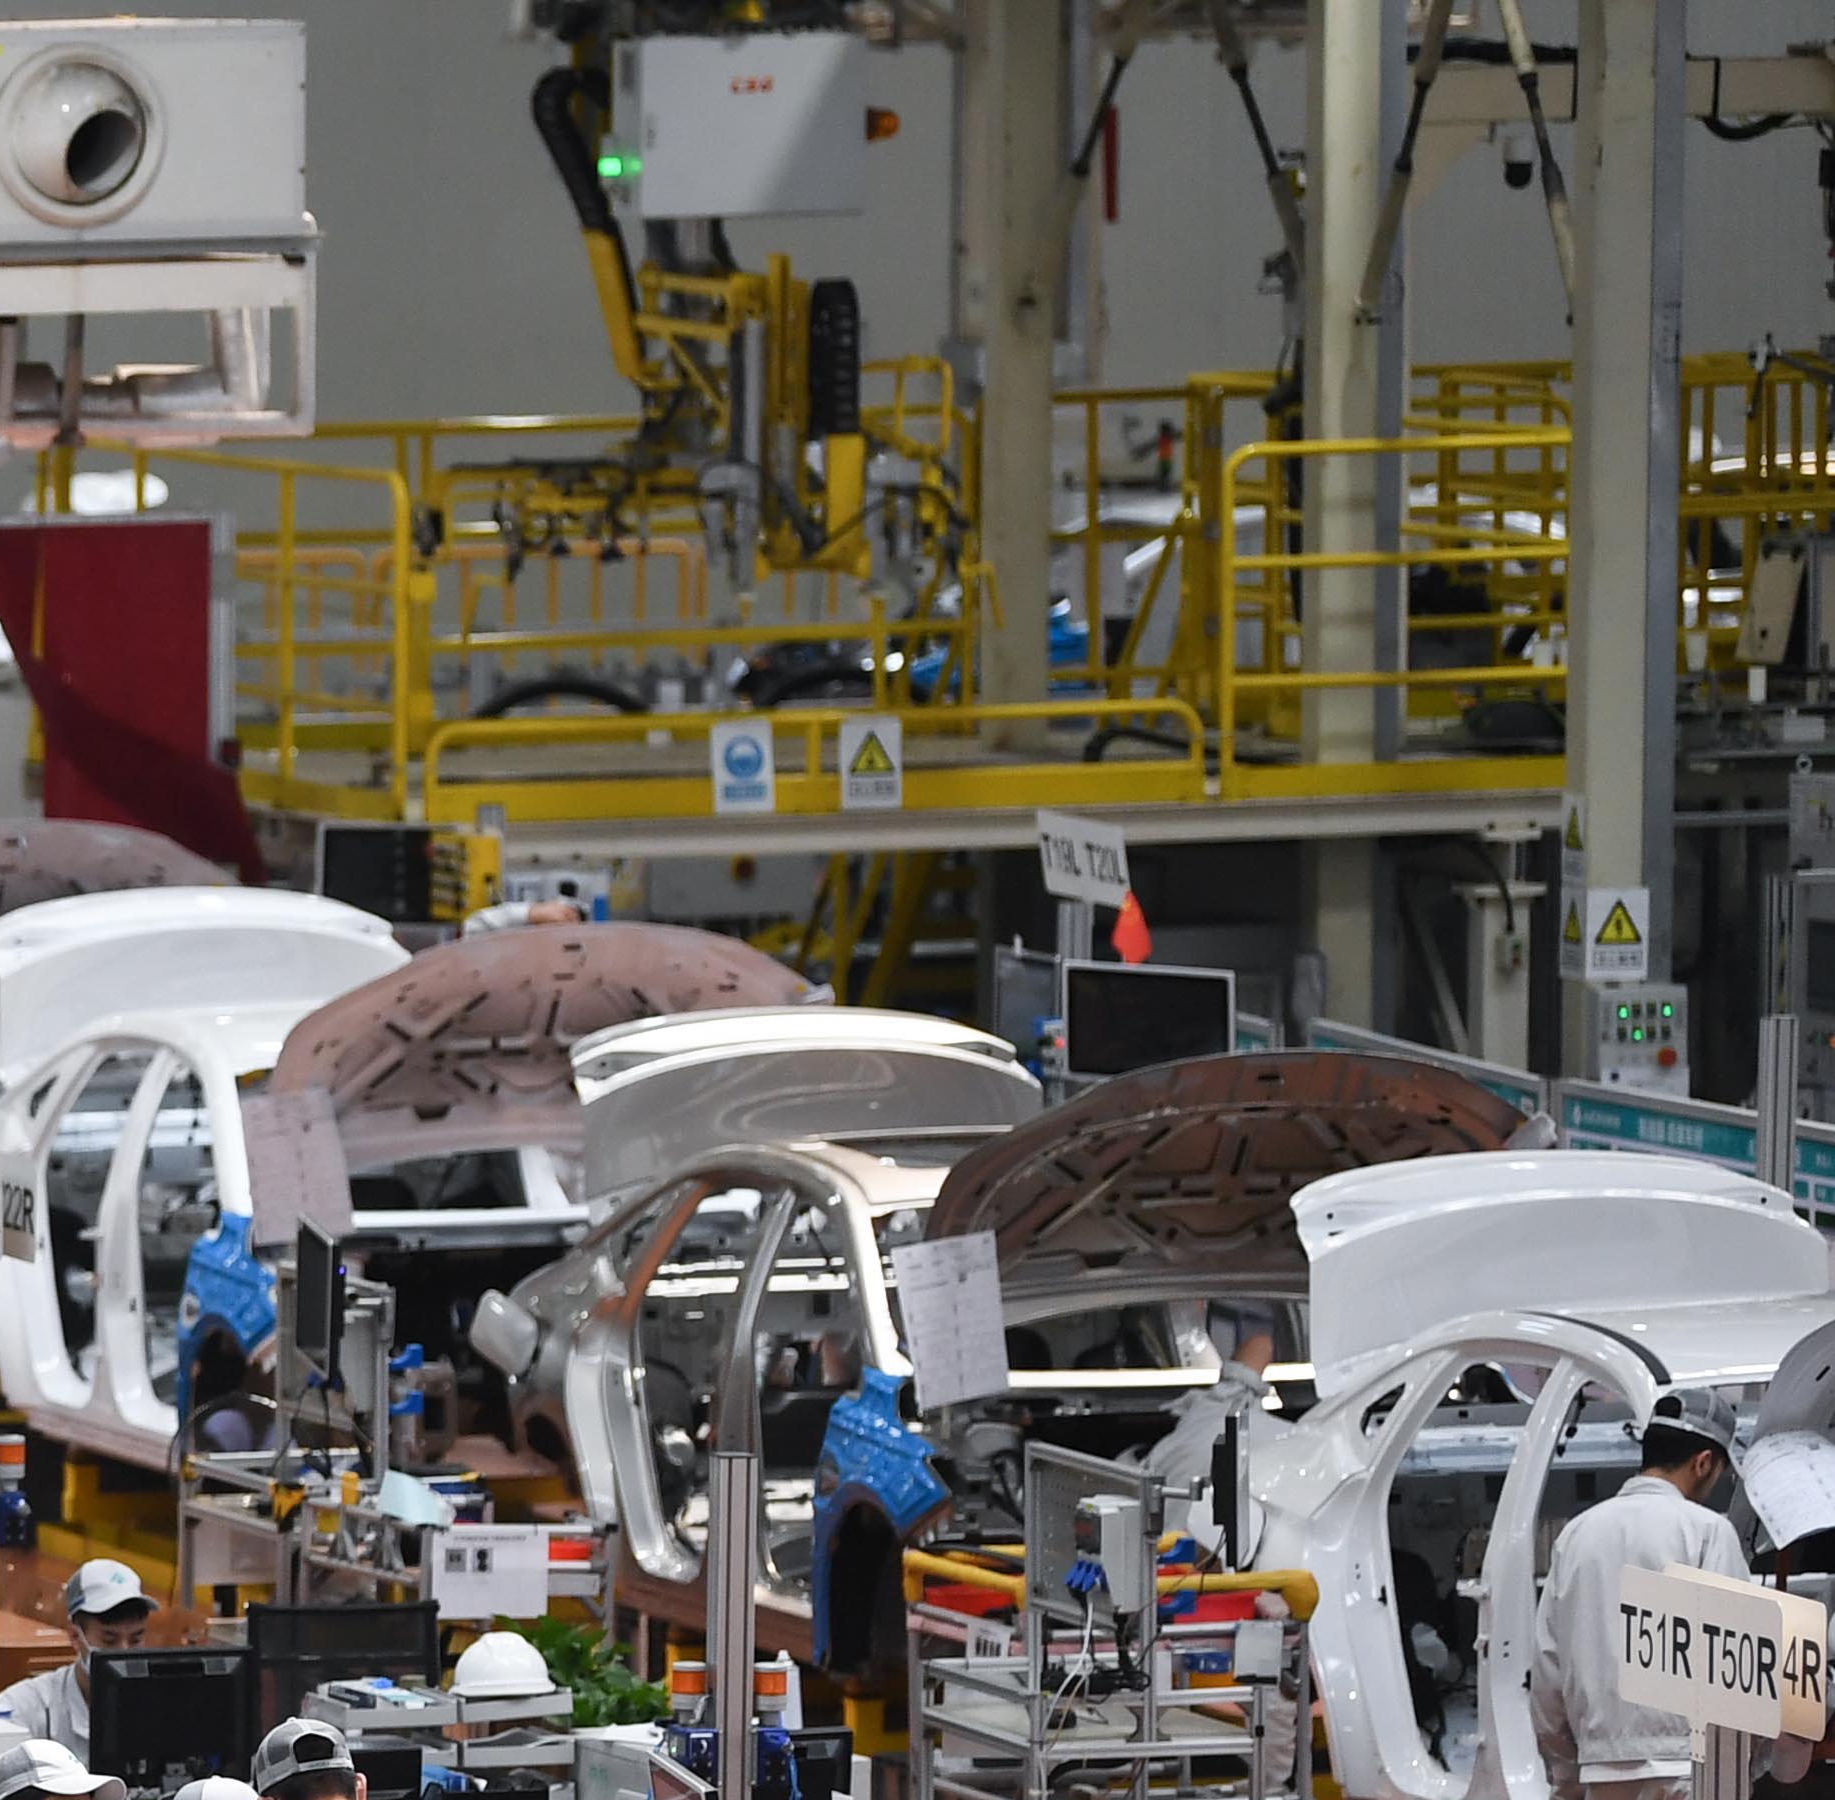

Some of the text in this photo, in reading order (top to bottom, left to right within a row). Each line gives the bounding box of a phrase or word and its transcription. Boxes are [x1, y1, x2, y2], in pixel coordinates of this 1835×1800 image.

[1620, 1603, 1778, 1700] T51R T50R
[1782, 1636, 1823, 1703] 4R
